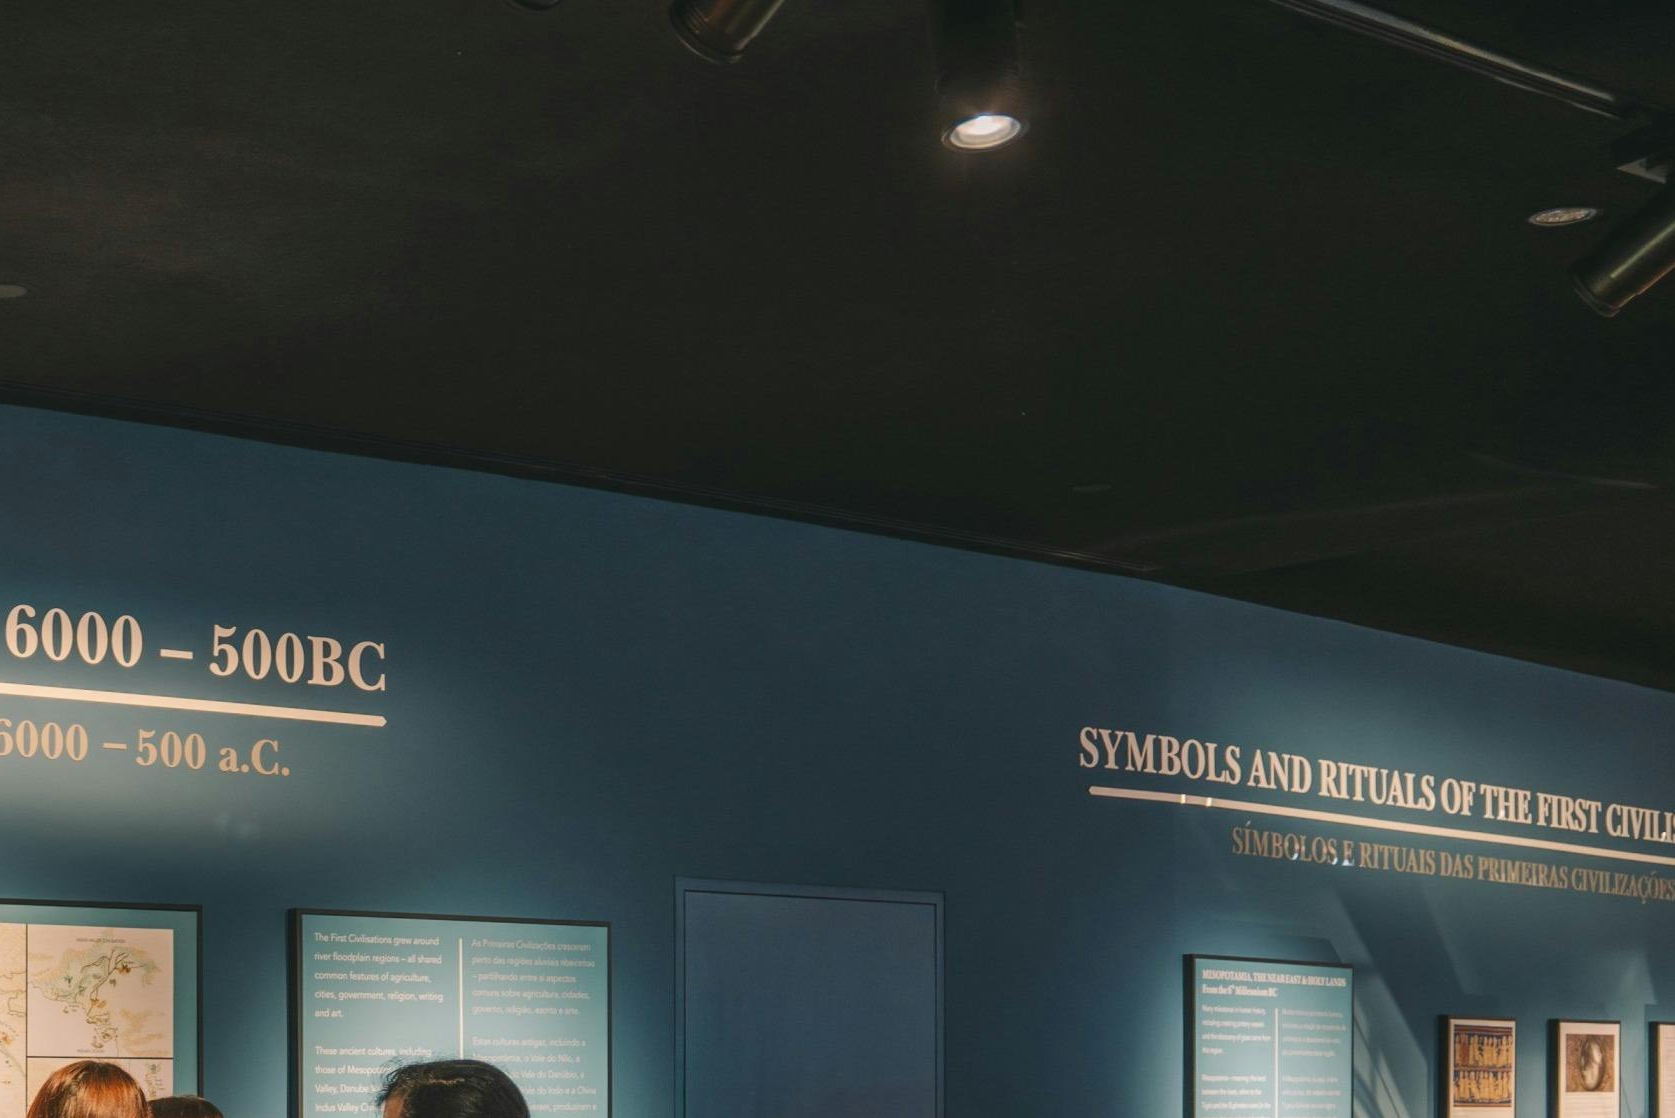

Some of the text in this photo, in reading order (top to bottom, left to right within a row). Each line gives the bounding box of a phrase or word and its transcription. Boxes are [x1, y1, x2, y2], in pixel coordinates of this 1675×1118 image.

[5, 604, 143, 668] 6000
[209, 624, 386, 691] 500BC
[135, 728, 206, 770] 500
[218, 738, 290, 777] a.C.
[1079, 727, 1241, 784] SYMBOLS
[1248, 751, 1312, 795] AND
[1319, 759, 1435, 811] RITUALS
[1441, 774, 1480, 816] OF
[1480, 784, 1532, 824] THE
[1536, 792, 1601, 833] FIRST
[1232, 820, 1337, 865] SÍMBOLOS
[1343, 841, 1356, 866] E
[1359, 845, 1436, 876] RITUAIS
[1440, 853, 1474, 879] DAS
[1478, 859, 1568, 889] PRIMEIRAS
[314, 932, 439, 946] The First Civilisations grew around
[314, 952, 331, 960] river
[332, 951, 370, 964] floodplain
[372, 953, 400, 964] regions
[406, 954, 416, 963] all
[417, 954, 442, 964] shared
[314, 971, 432, 984] common features of agriculture,
[314, 990, 443, 1003] cities, government, religion, writing
[314, 1007, 344, 1017] and art.
